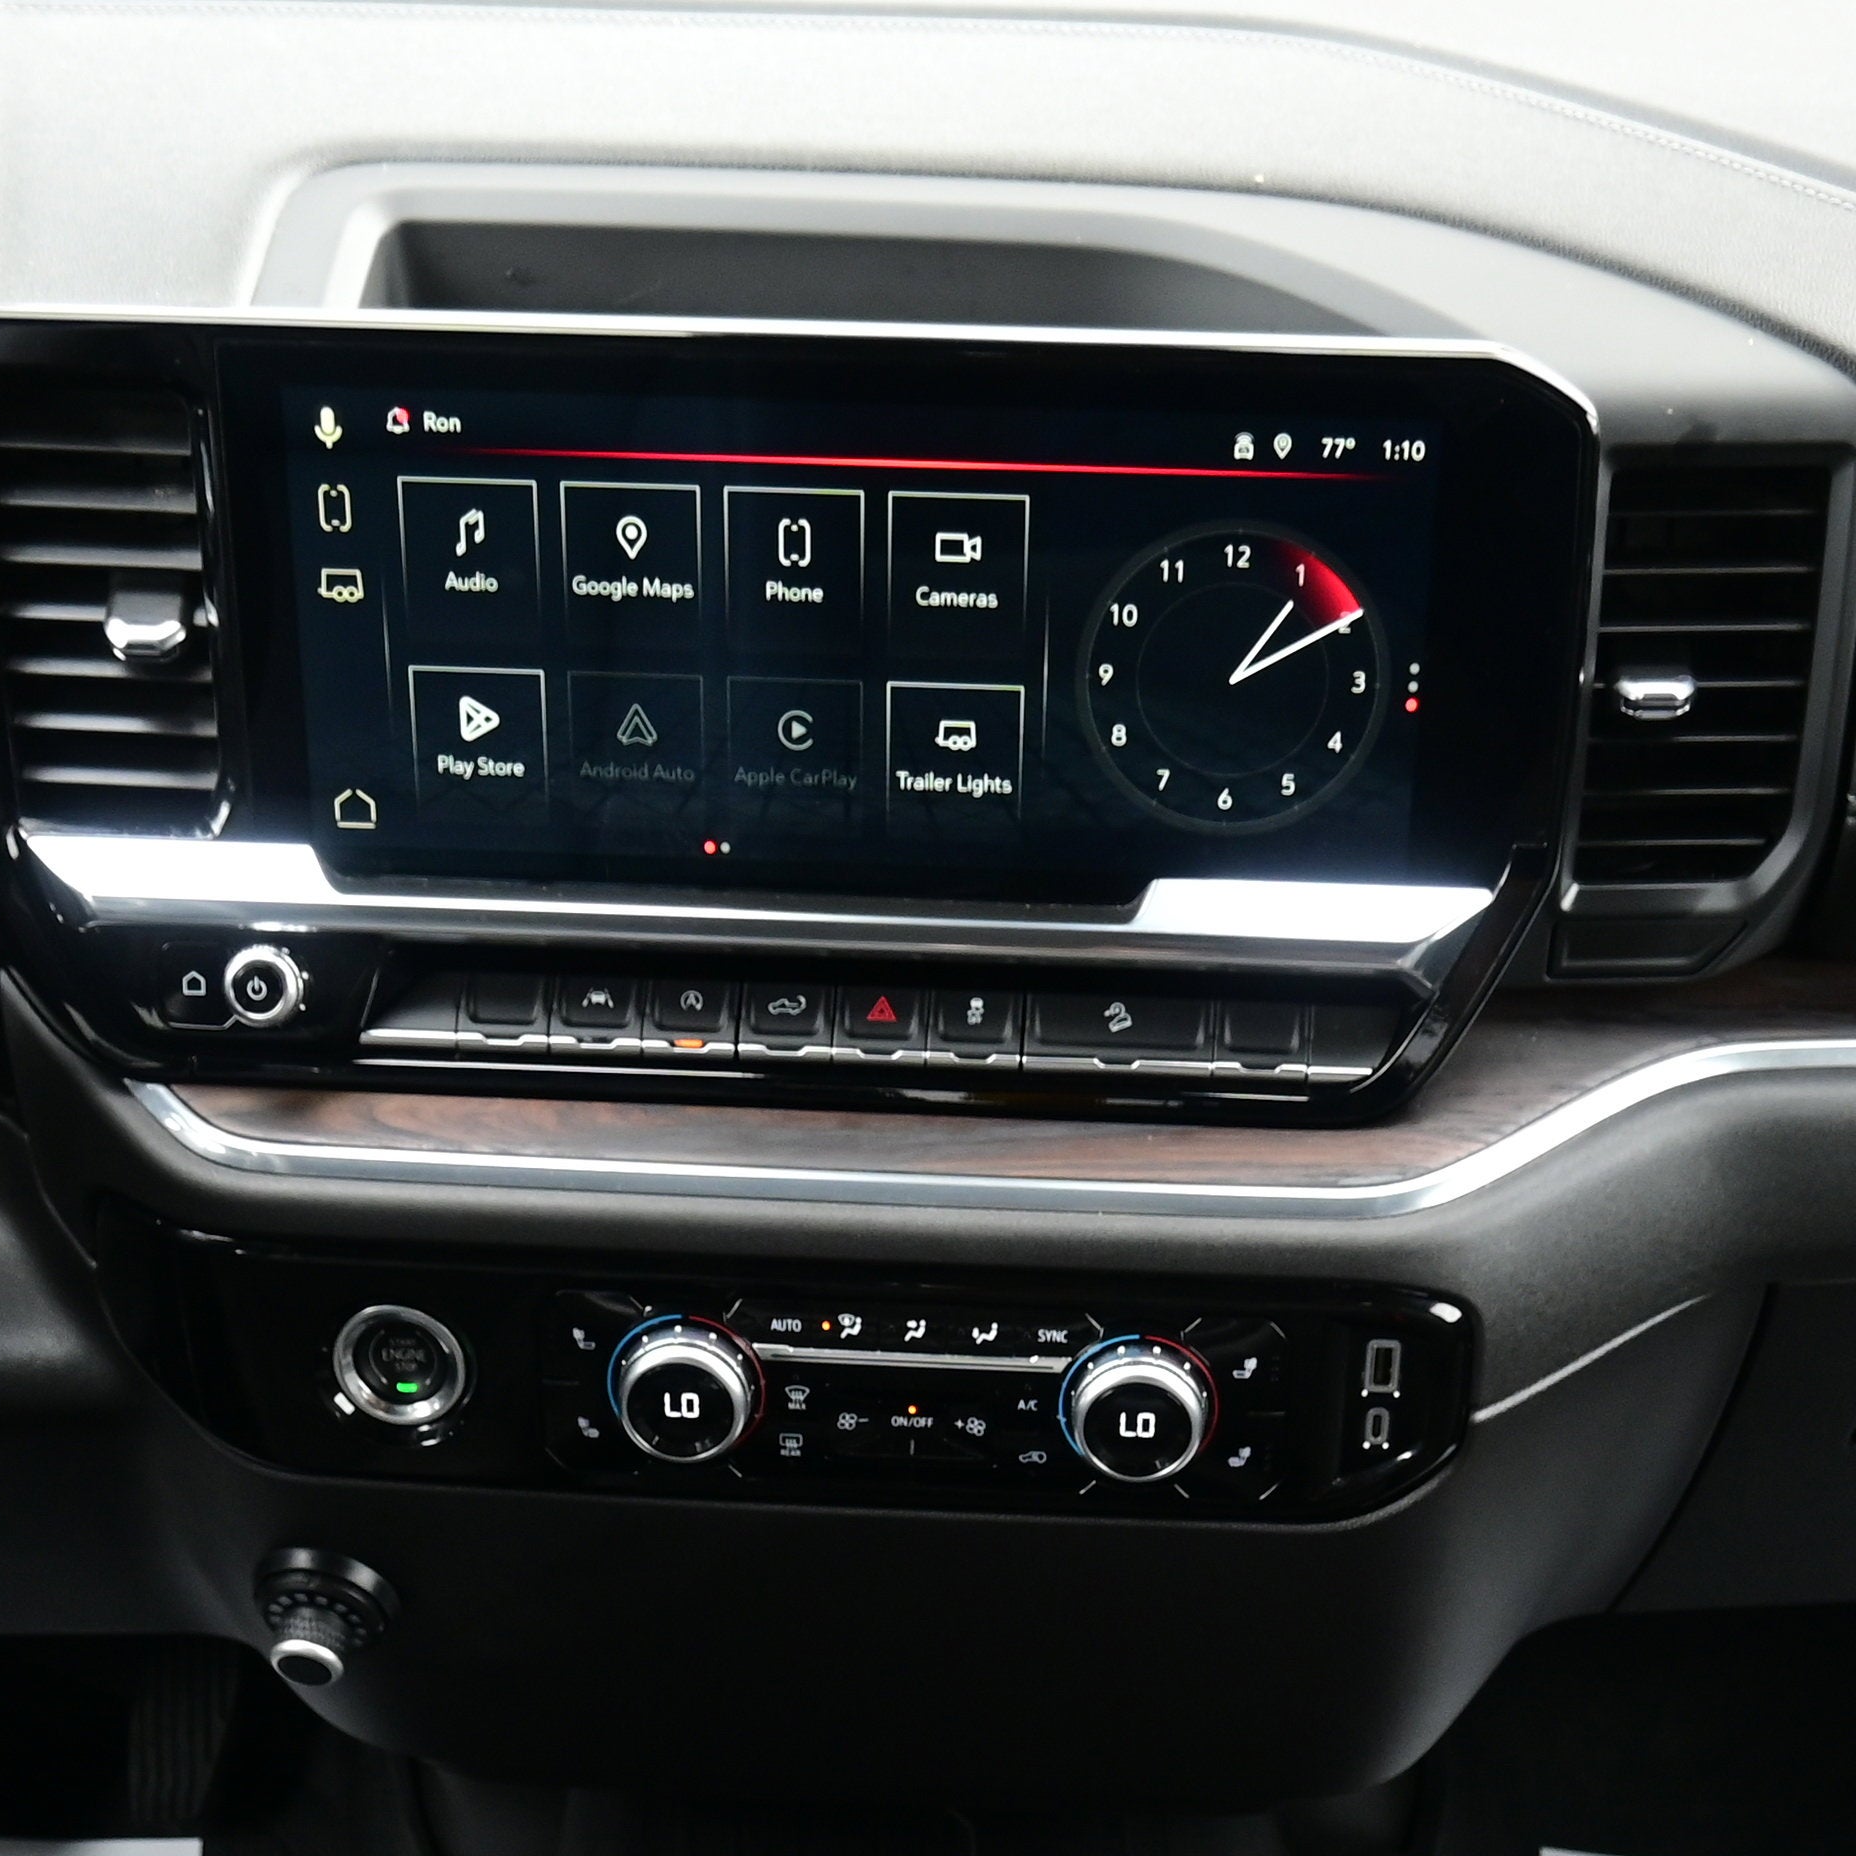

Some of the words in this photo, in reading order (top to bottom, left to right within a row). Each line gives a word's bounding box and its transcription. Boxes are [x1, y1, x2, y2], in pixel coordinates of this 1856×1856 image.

[423, 411, 461, 433] Ron
[1382, 439, 1426, 463] 1:10
[1224, 545, 1251, 568] 12
[445, 570, 499, 592] Audio
[1159, 559, 1185, 582] 11
[1296, 564, 1306, 587] 1
[572, 575, 638, 602] Google
[642, 576, 695, 603] Maps
[765, 580, 824, 603] Phone
[915, 586, 999, 608] Cameras
[1110, 604, 1139, 627] 10
[1098, 664, 1114, 685] 9
[1351, 672, 1366, 693] 3
[1111, 725, 1127, 747] 8
[1327, 732, 1343, 753] 4
[437, 755, 474, 780] Play
[477, 756, 525, 778] Store
[579, 760, 649, 780] Android
[652, 762, 694, 781] Auto
[734, 766, 784, 787] Apple
[790, 768, 857, 791] CarPlay
[896, 770, 952, 791] Trailer
[957, 773, 1013, 798] Lights
[1156, 769, 1170, 790] 7
[1281, 774, 1296, 796] 5
[1218, 789, 1232, 810] 6
[770, 1318, 801, 1333] AUTO
[1037, 1329, 1069, 1344] SYNC
[664, 1392, 700, 1418] LO
[787, 1401, 806, 1411] MAX
[1017, 1399, 1038, 1412] A/C
[891, 1416, 934, 1429] ON/OFF
[1119, 1411, 1155, 1438] LO
[780, 1448, 801, 1457] REAR
